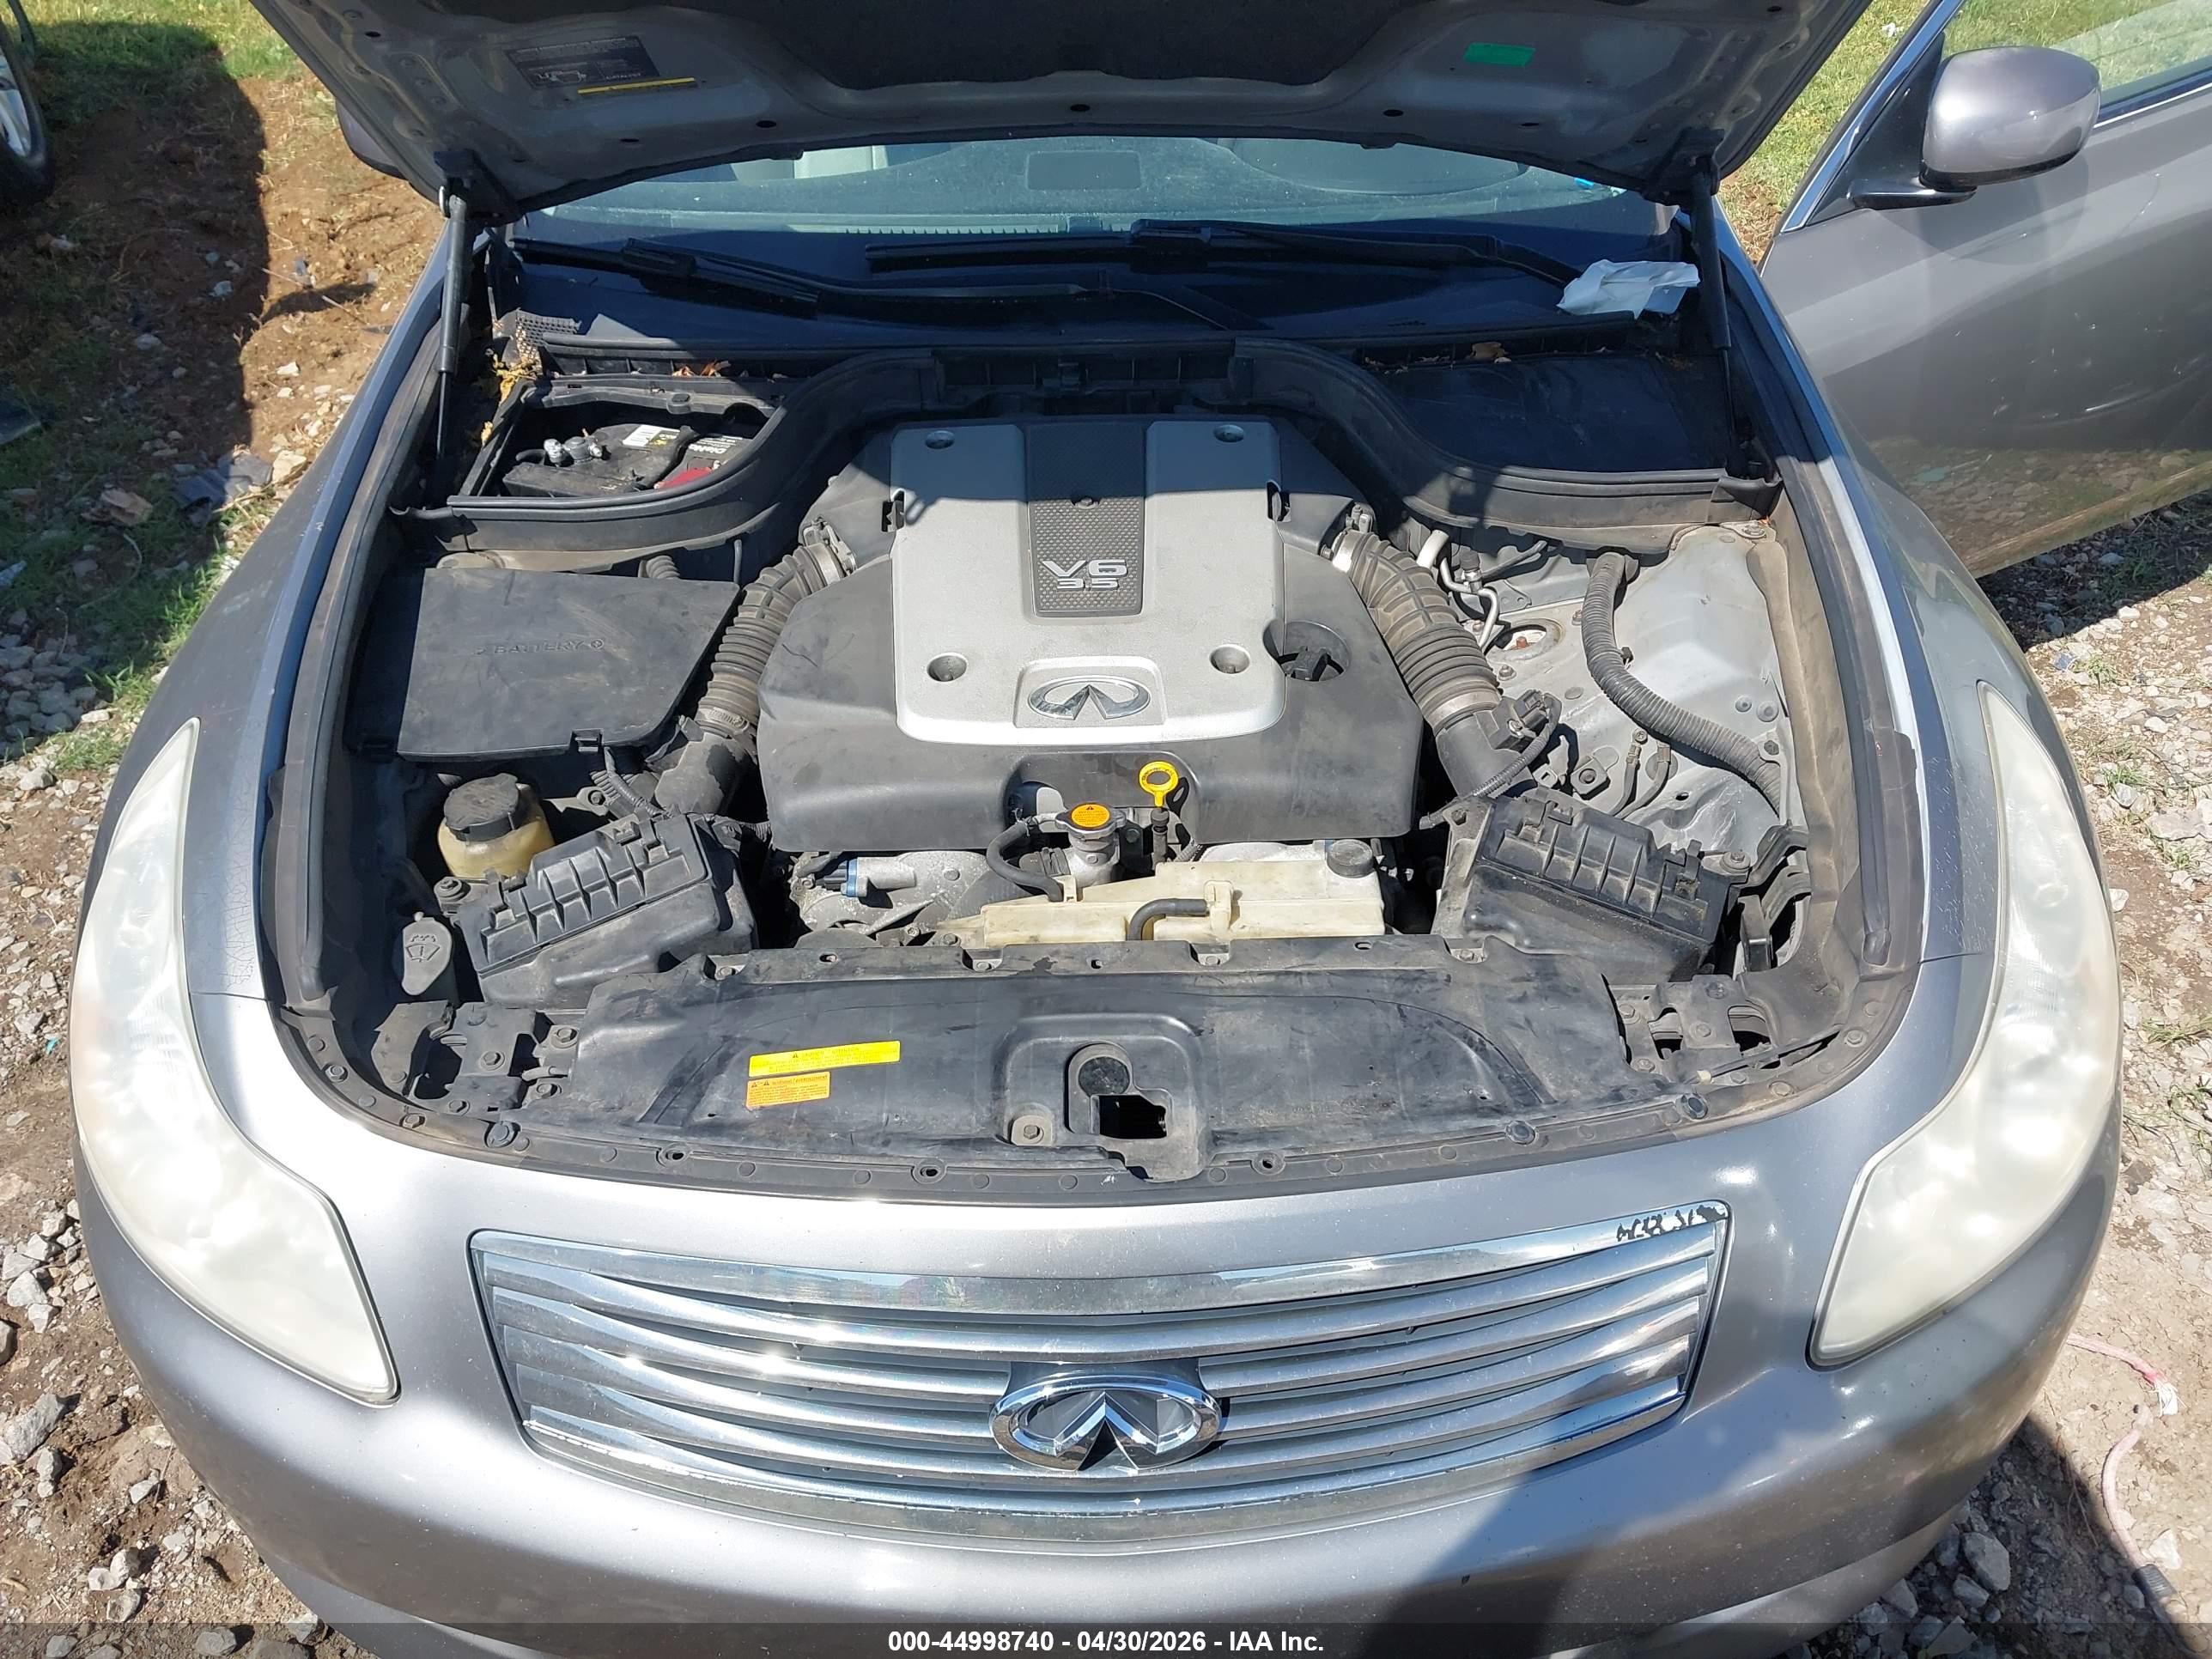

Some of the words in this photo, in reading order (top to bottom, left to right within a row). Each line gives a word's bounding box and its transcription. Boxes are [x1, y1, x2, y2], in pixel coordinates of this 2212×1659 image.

[1042, 559, 1127, 578] V6
[1056, 577, 1119, 590] 3.5
[494, 640, 583, 653] BATTERY
